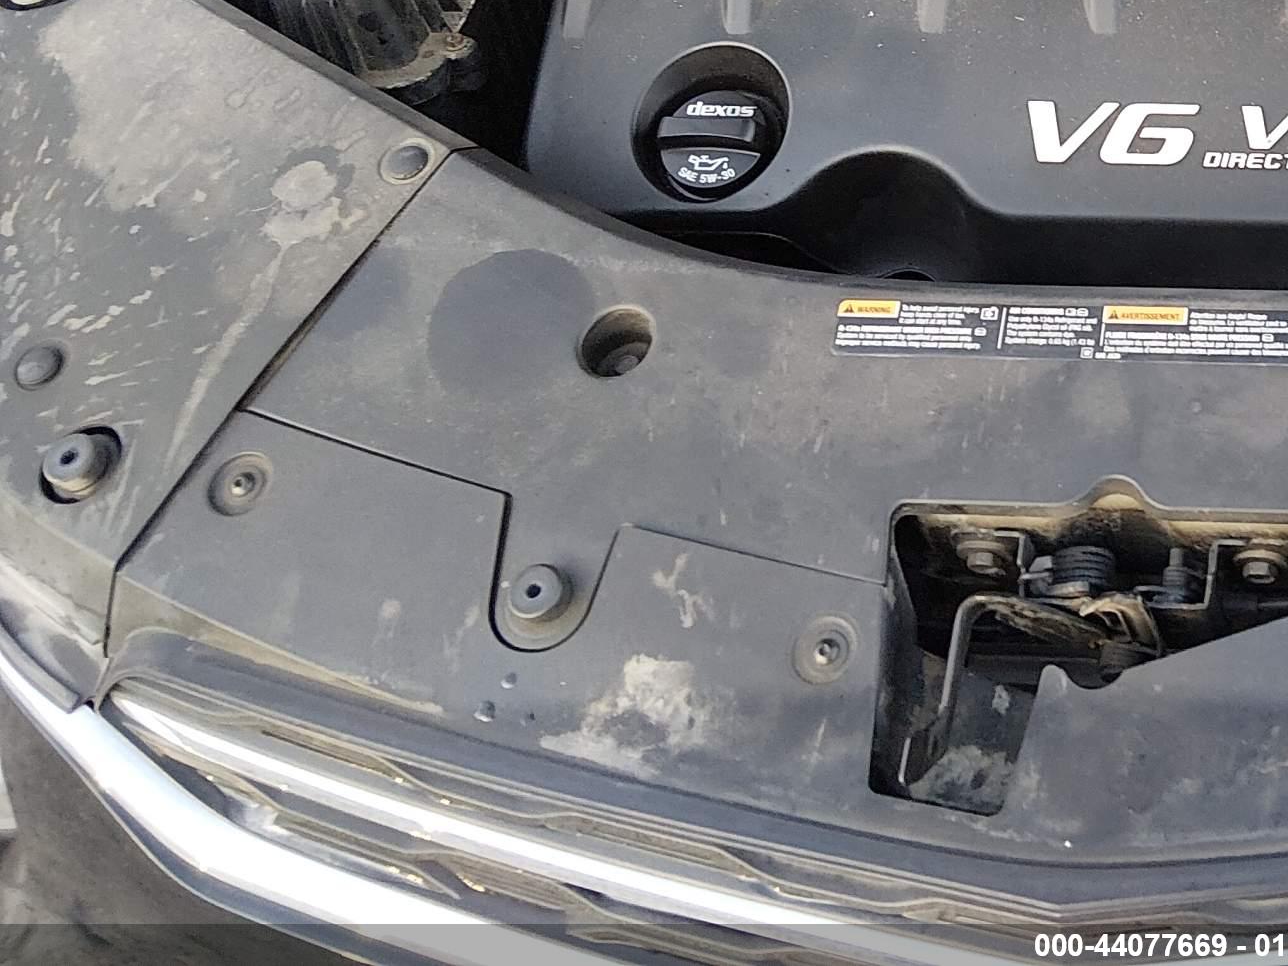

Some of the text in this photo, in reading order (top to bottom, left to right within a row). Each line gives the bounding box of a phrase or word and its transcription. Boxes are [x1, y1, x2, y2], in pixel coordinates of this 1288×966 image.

[686, 101, 757, 117] dexos
[1027, 100, 1201, 166] V6
[678, 167, 736, 184] SAE 5W-30
[1120, 311, 1180, 321] AVERTISSEMENT
